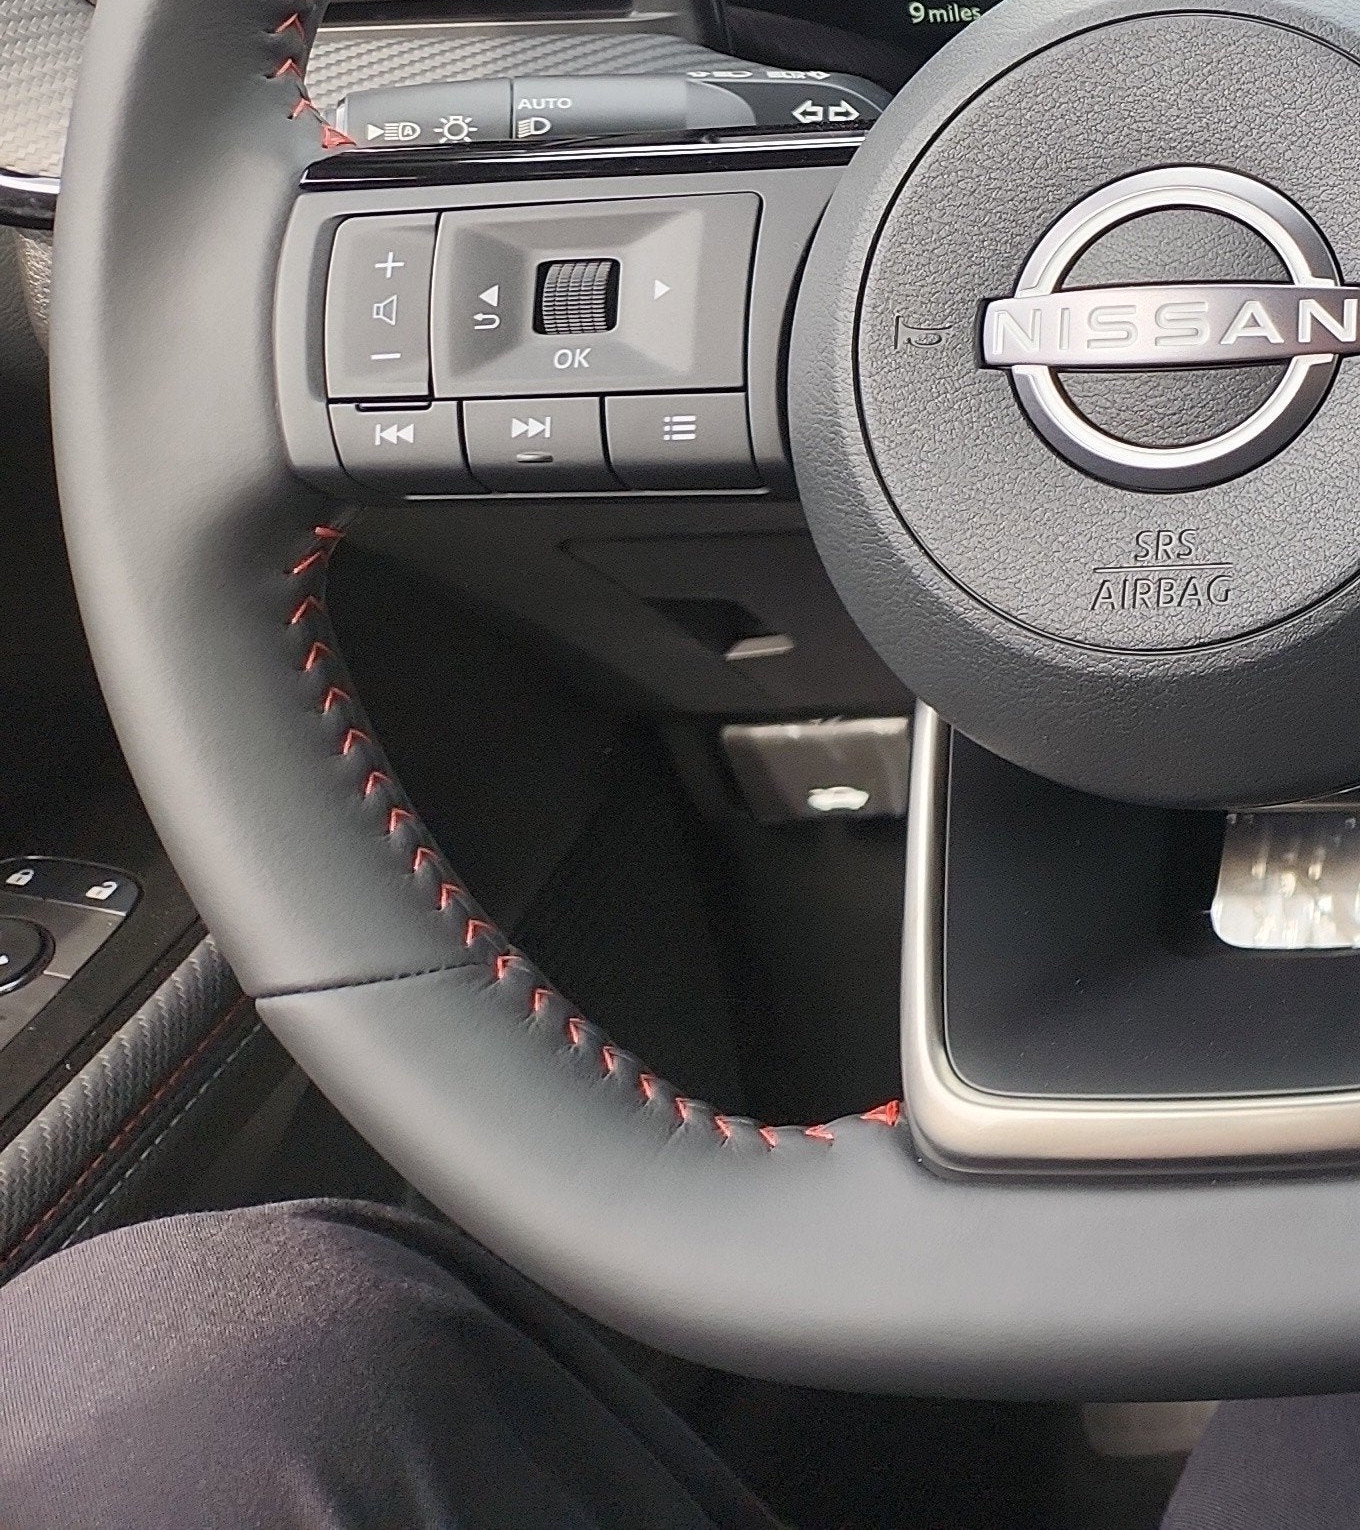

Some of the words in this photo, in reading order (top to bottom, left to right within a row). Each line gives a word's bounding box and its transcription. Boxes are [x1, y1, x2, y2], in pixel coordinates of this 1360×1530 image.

[908, 1, 925, 24] 9
[928, 4, 982, 24] miles
[517, 97, 573, 110] AUTO
[991, 296, 1359, 357] NISSAN
[553, 347, 593, 370] OK
[1134, 528, 1199, 562] SRS
[1090, 573, 1234, 612] AIRBAG
